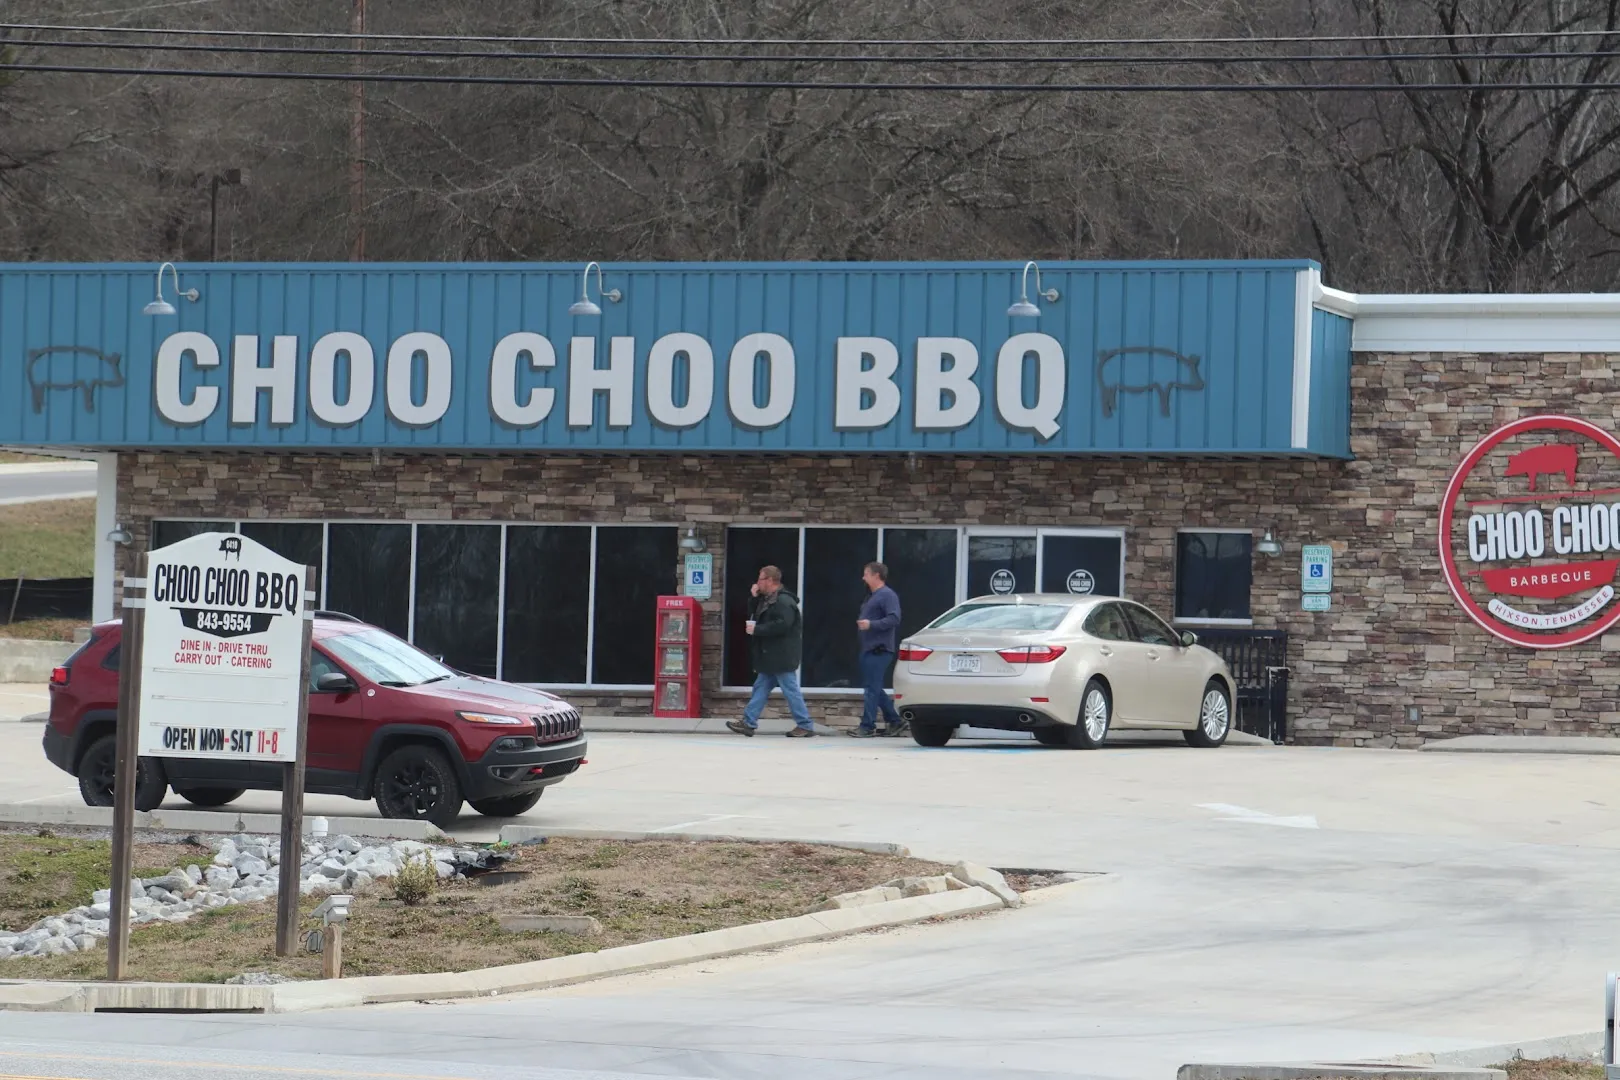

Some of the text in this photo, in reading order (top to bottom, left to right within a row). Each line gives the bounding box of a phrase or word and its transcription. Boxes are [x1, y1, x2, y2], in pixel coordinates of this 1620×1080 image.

[156, 331, 1066, 439] CHOO CHOO BBQ
[1468, 509, 1545, 562] CHOO
[154, 563, 298, 616] CHOO CHOO BBQ
[1510, 570, 1591, 587] BARBEQUE
[197, 612, 251, 631] 843-9554
[1545, 590, 1610, 626] TENNESSEE
[175, 652, 202, 664] CARRY
[205, 655, 222, 665] OUT
[232, 656, 272, 669] CATERING
[181, 639, 201, 651] DINE
[202, 641, 211, 651] IN
[218, 642, 243, 654] DRIVE
[246, 643, 268, 656] THRU
[164, 726, 279, 754] OPEN MON-SAT 11-8
